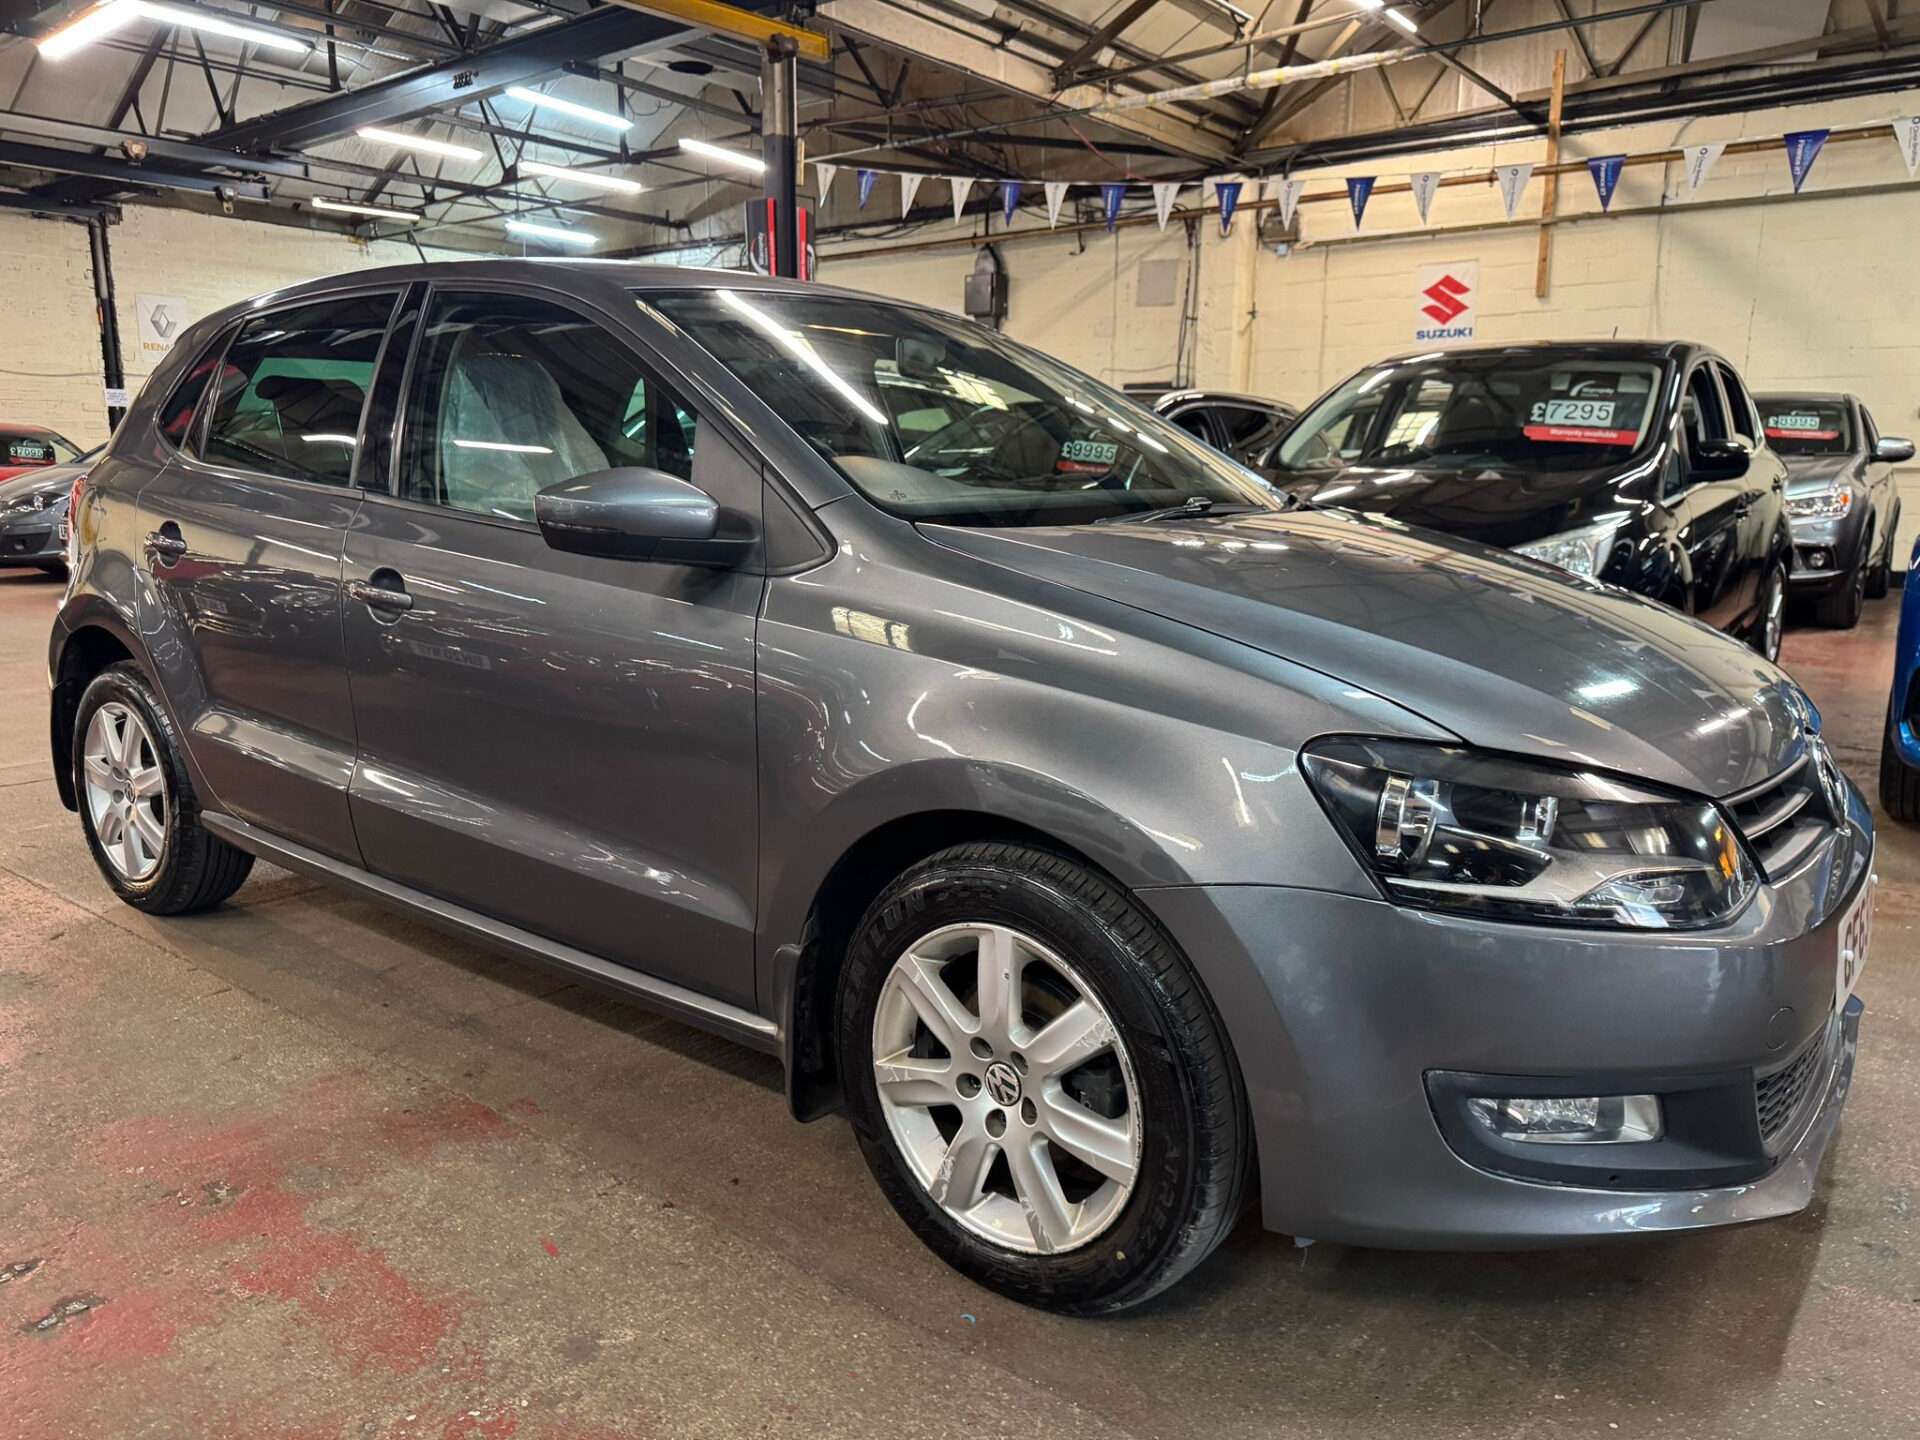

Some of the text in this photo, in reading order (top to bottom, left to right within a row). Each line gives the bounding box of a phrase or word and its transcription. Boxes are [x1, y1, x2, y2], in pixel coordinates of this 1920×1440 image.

[1416, 326, 1473, 340] SUZUKI
[143, 342, 172, 352] RENA
[1529, 401, 1612, 422] £7295
[1061, 441, 1115, 460] £9995
